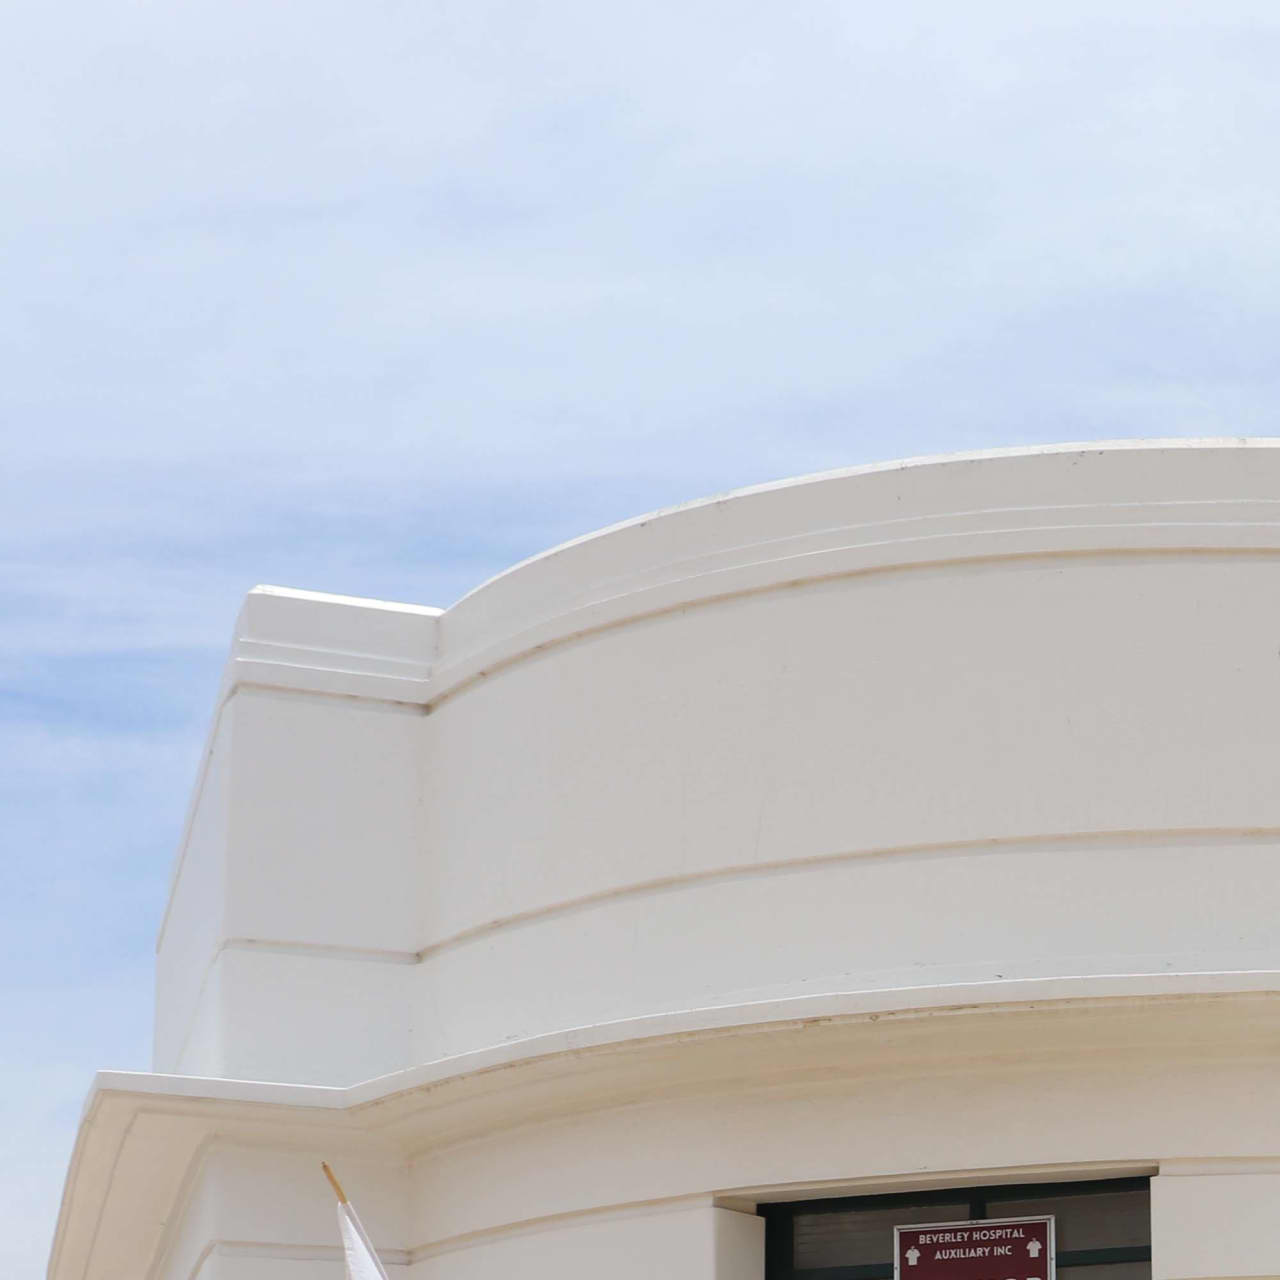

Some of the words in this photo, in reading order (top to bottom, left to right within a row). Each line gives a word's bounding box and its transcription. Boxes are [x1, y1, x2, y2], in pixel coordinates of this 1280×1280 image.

[919, 1231, 970, 1245] BEVERLEY
[973, 1228, 1025, 1241] HOSPITAL
[934, 1246, 991, 1260] AUXILIARY
[993, 1245, 1013, 1257] INC
